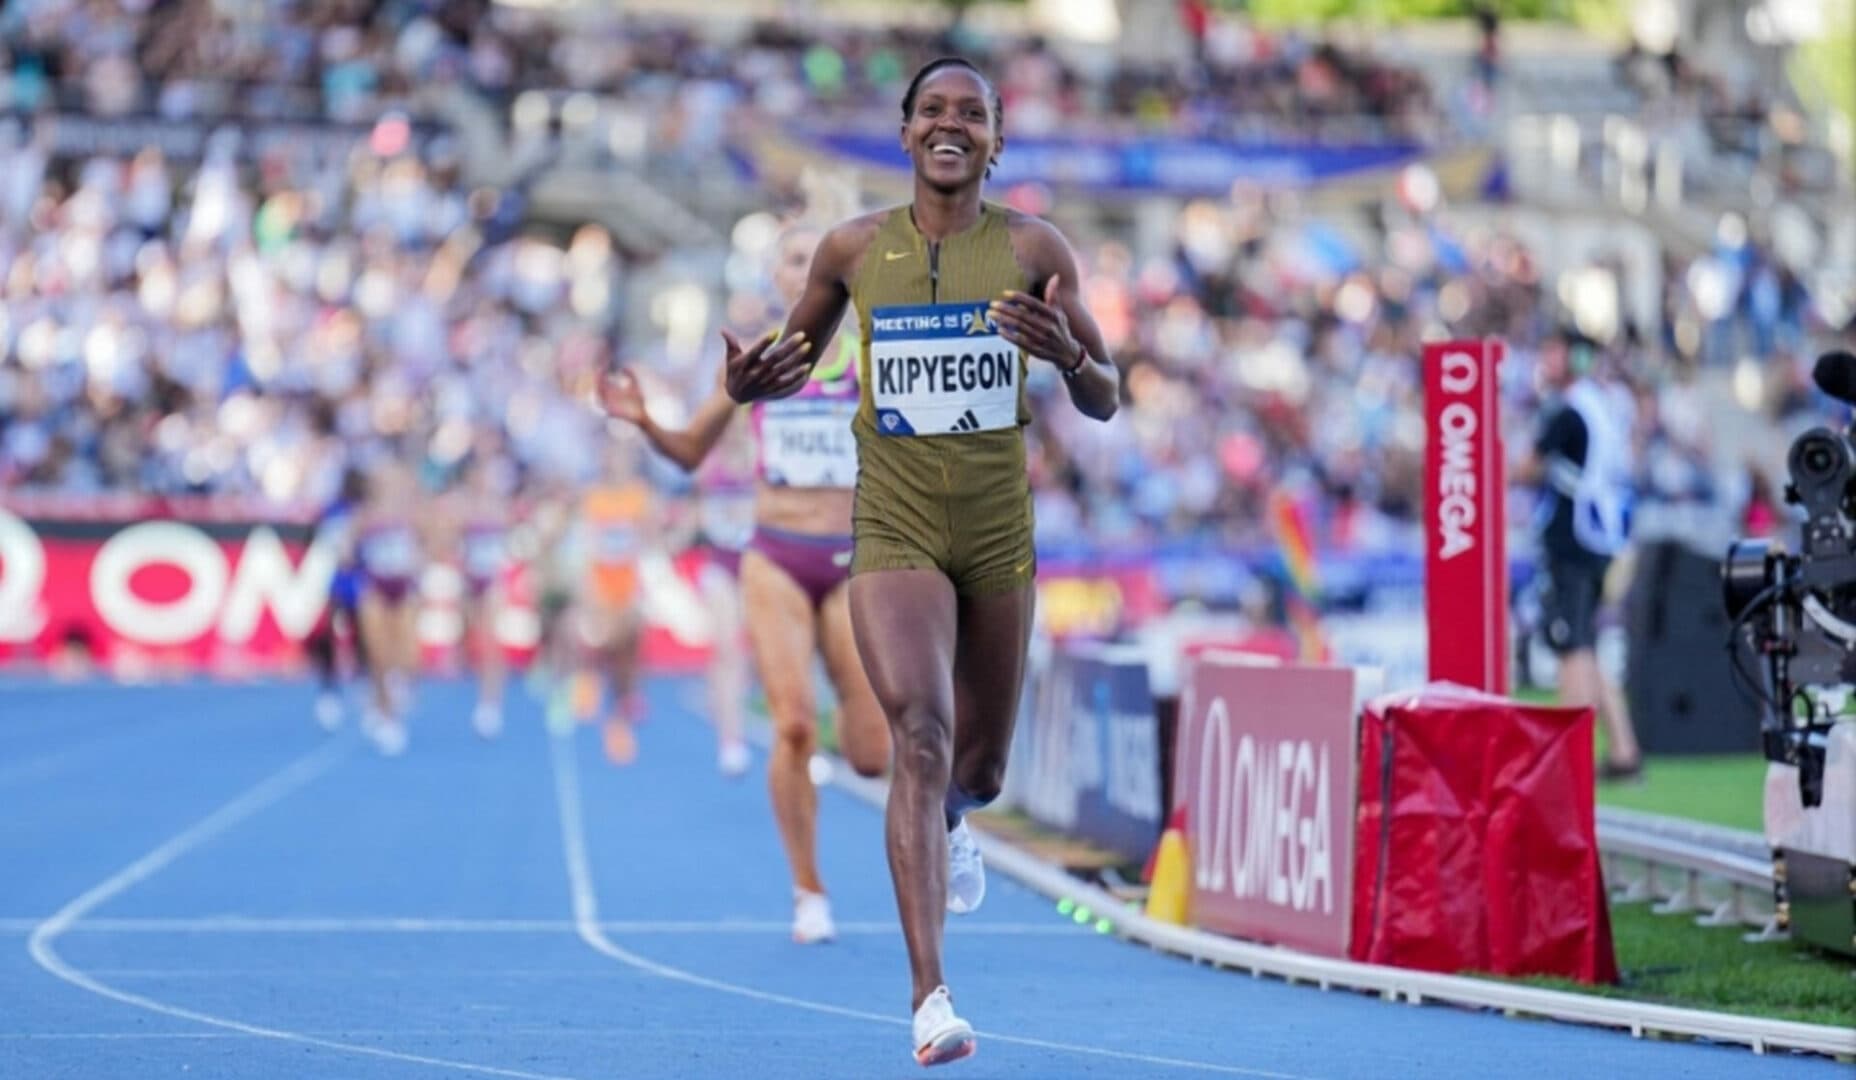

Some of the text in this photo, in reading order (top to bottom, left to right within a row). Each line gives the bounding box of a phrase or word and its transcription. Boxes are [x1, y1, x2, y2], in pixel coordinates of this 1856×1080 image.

[872, 316, 941, 331] MEETING
[878, 351, 1012, 395] KIPYEGON
[1438, 402, 1477, 560] OMEGA
[1231, 735, 1333, 915] OMEGA
